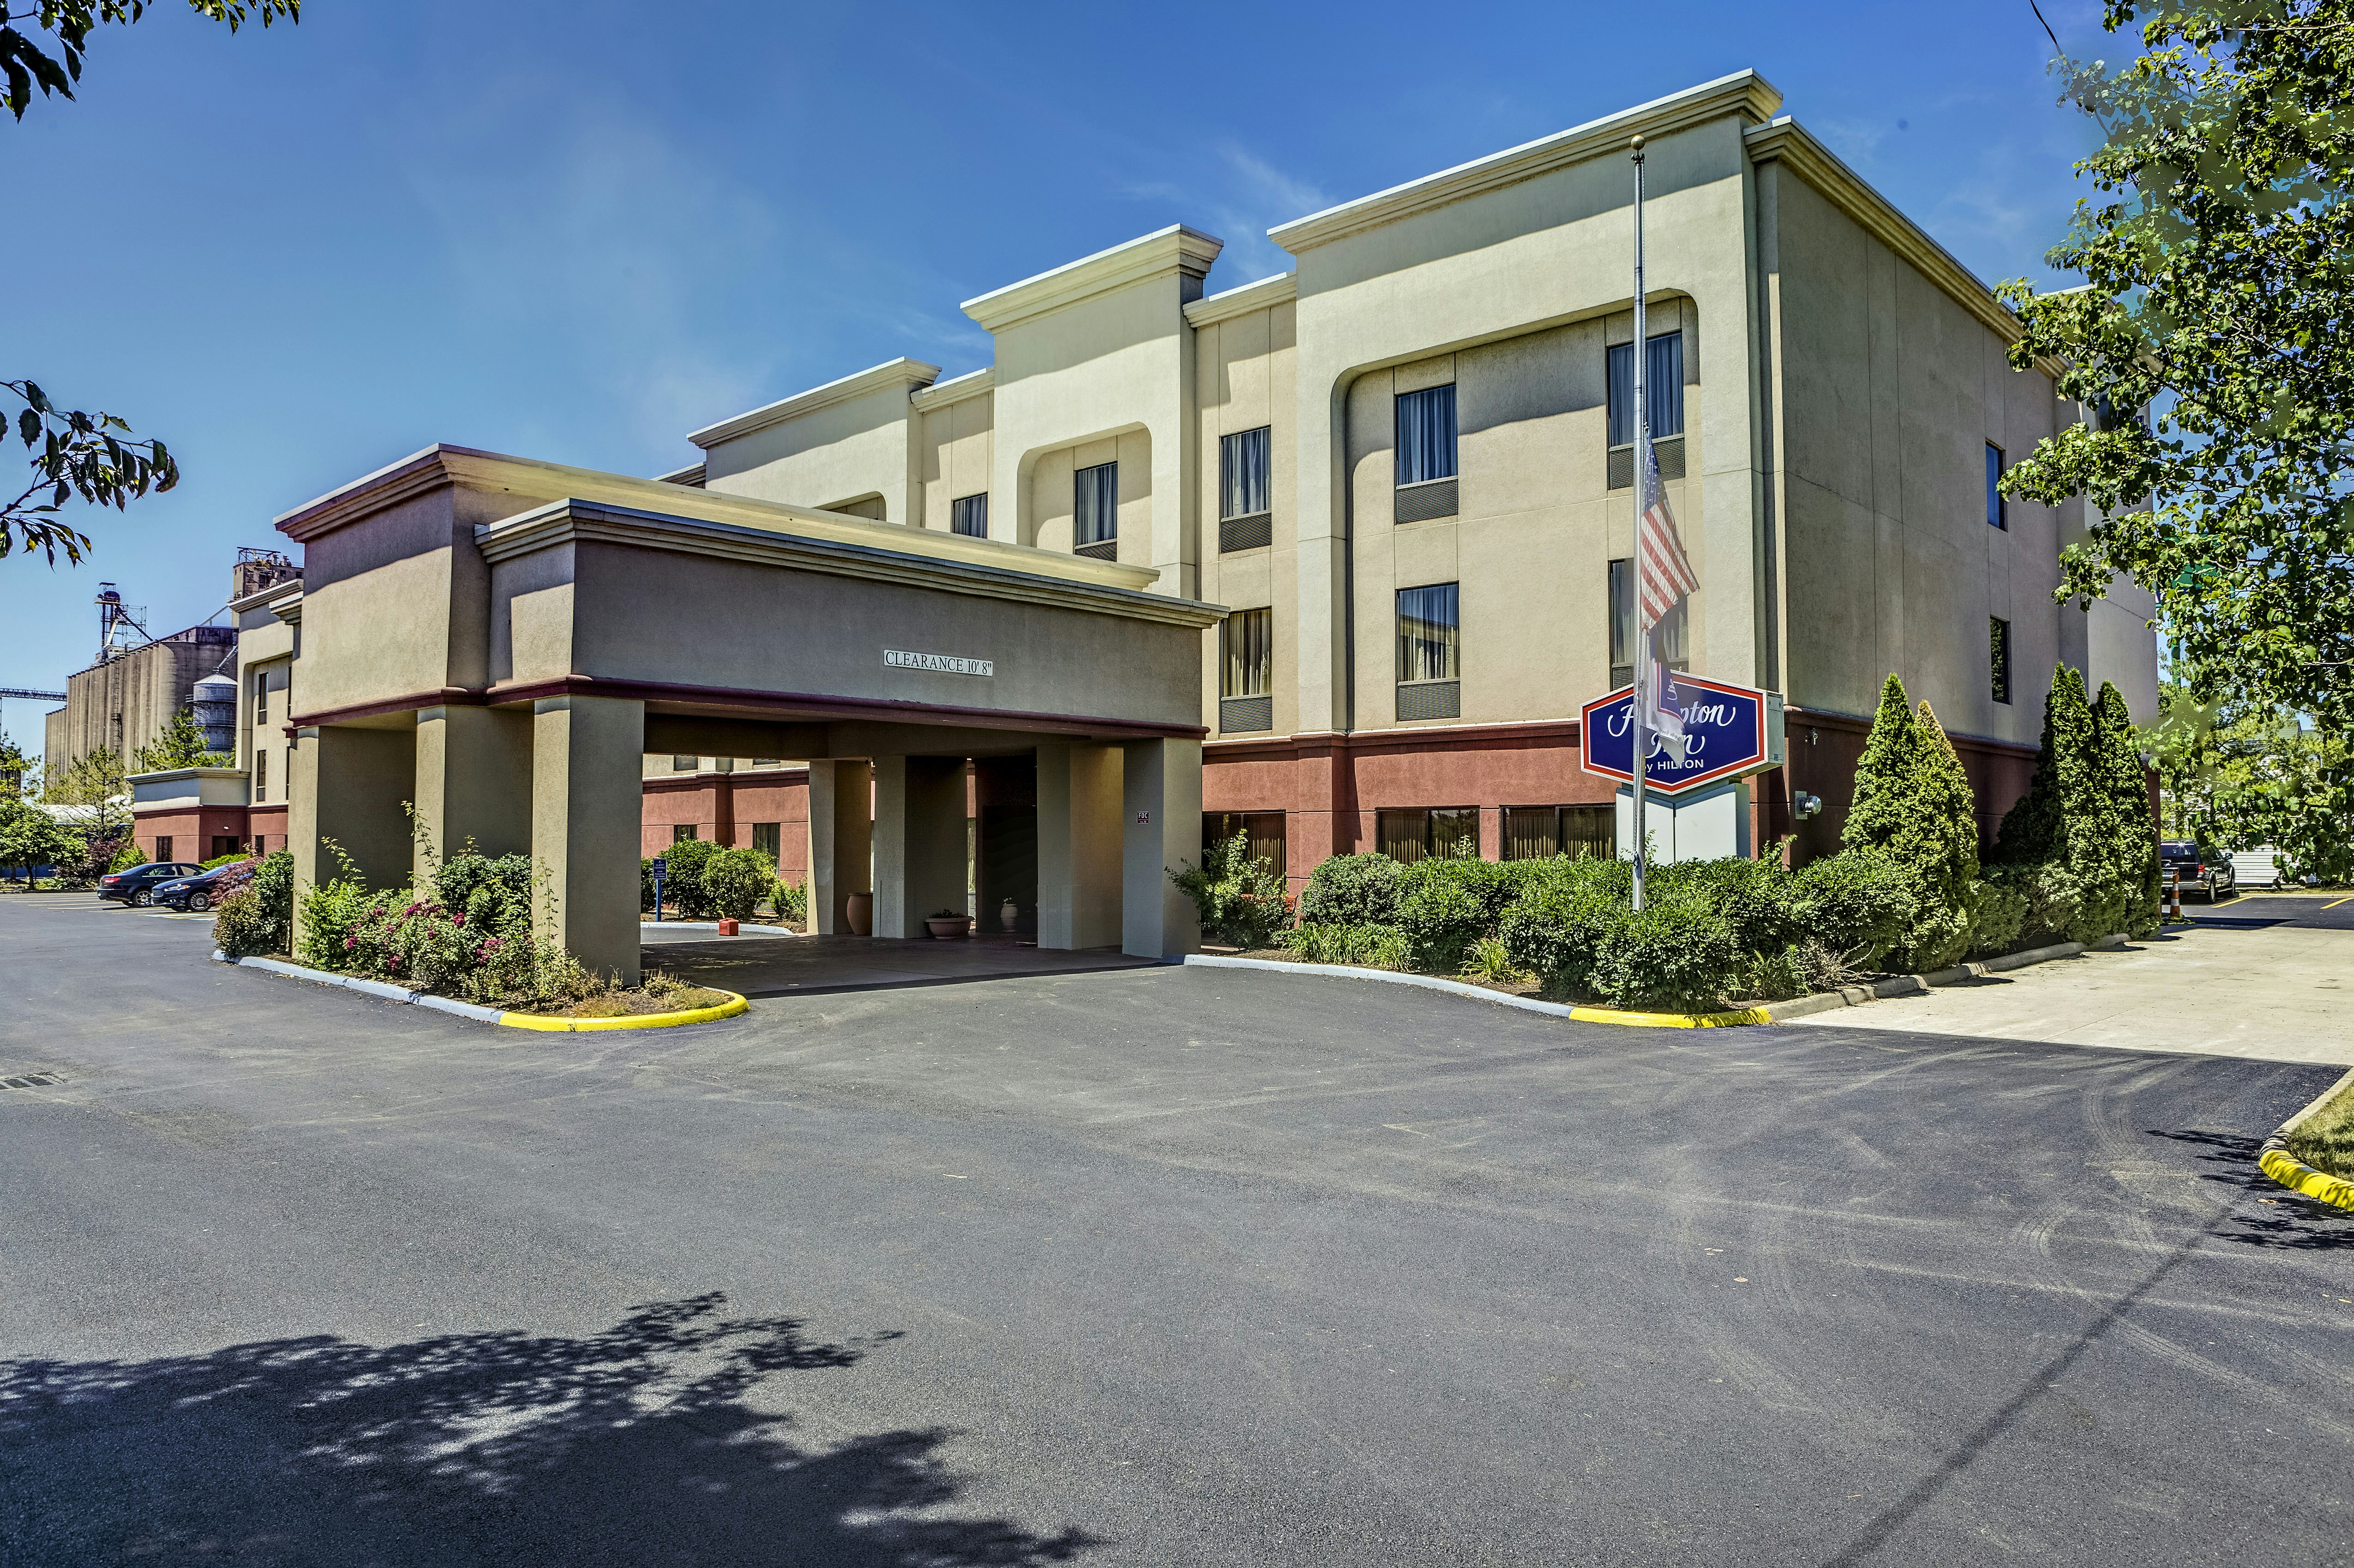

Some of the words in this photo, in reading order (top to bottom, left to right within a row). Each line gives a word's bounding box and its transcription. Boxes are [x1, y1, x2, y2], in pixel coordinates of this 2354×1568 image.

[885, 651, 963, 672] CLEARANCE
[967, 661, 979, 673] 10'
[982, 662, 991, 674] 8"
